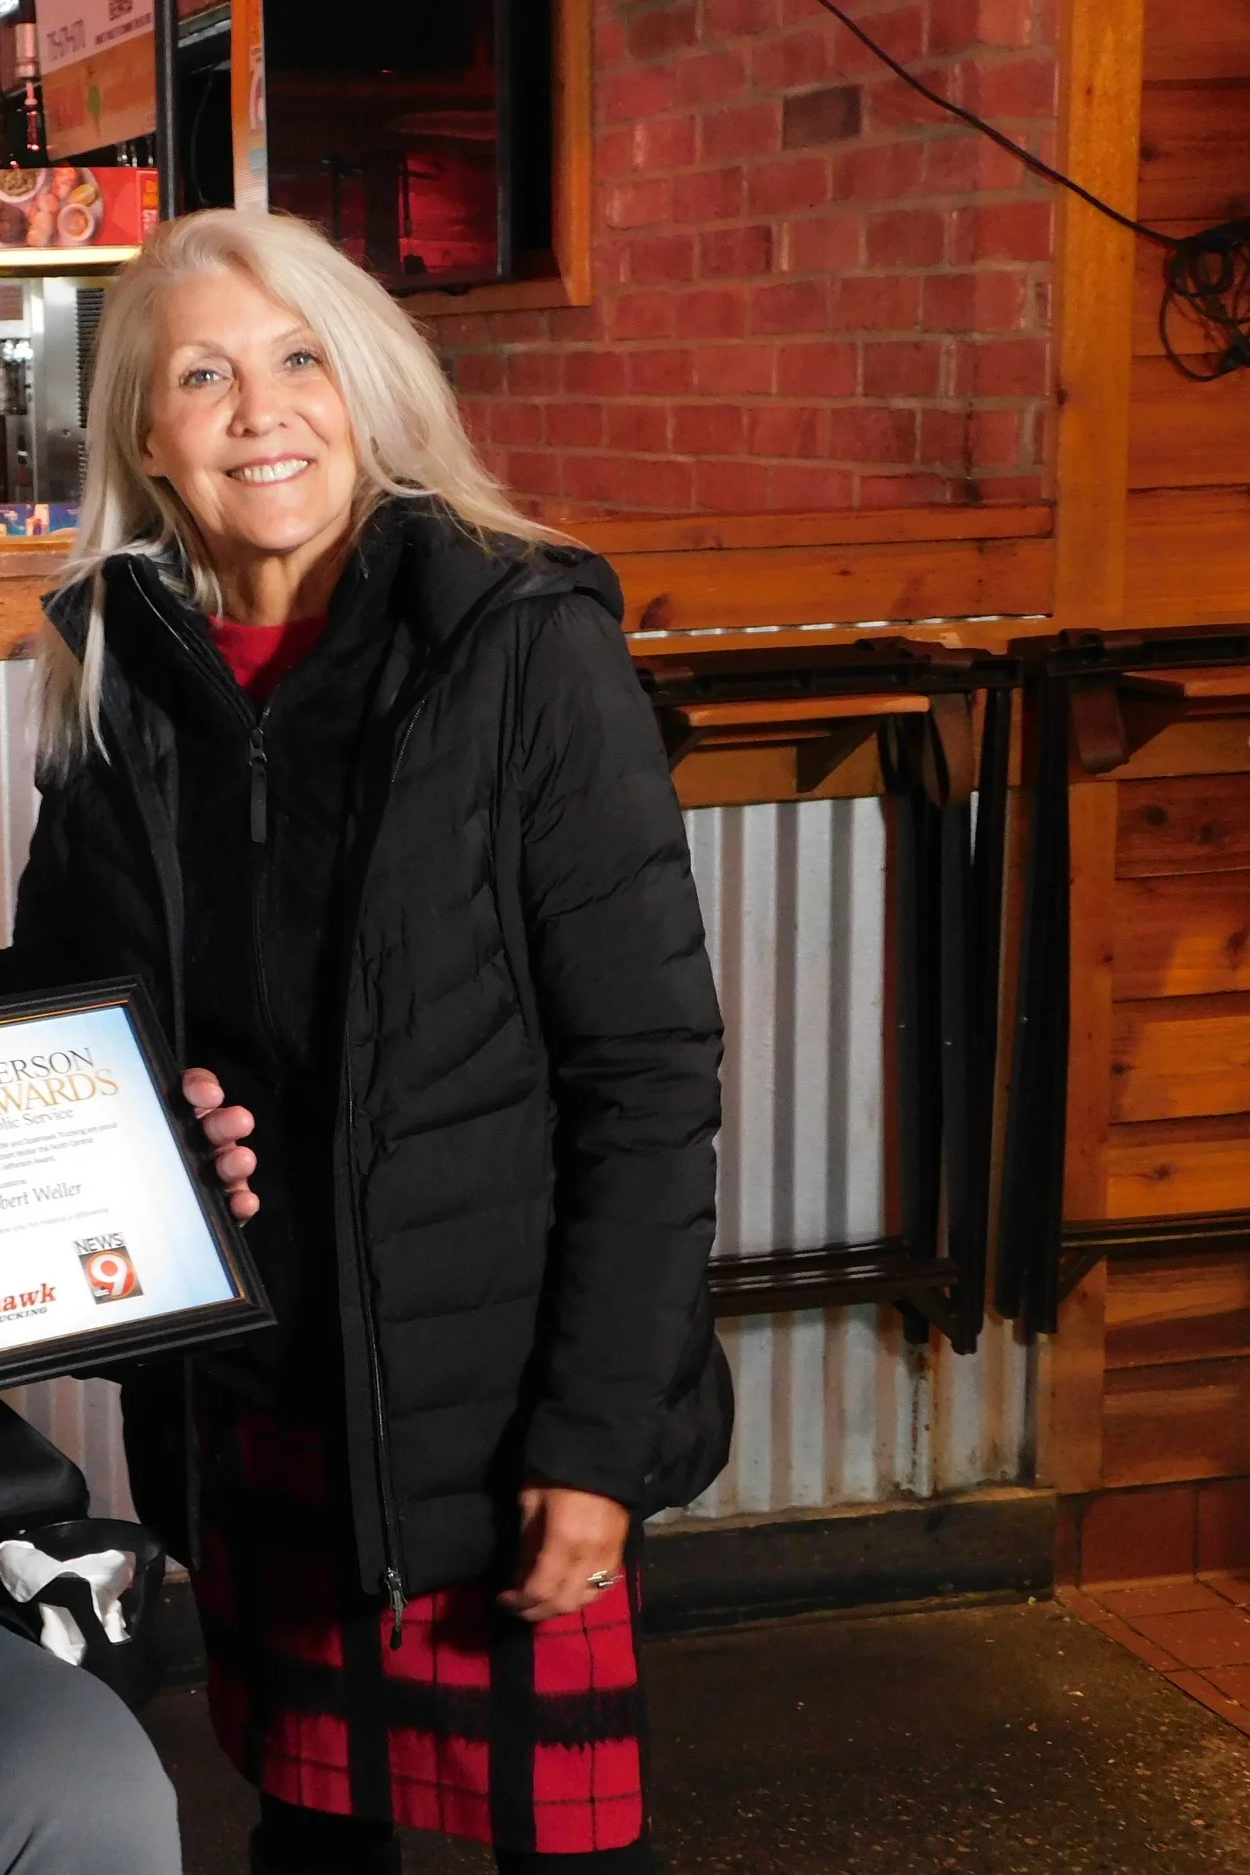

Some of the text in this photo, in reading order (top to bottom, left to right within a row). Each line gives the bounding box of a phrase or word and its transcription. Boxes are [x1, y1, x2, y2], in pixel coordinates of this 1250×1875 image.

[22, 1107, 75, 1125] Service
[32, 1182, 82, 1203] Weller
[73, 1232, 126, 1254] NEWS
[89, 1253, 128, 1297] 9
